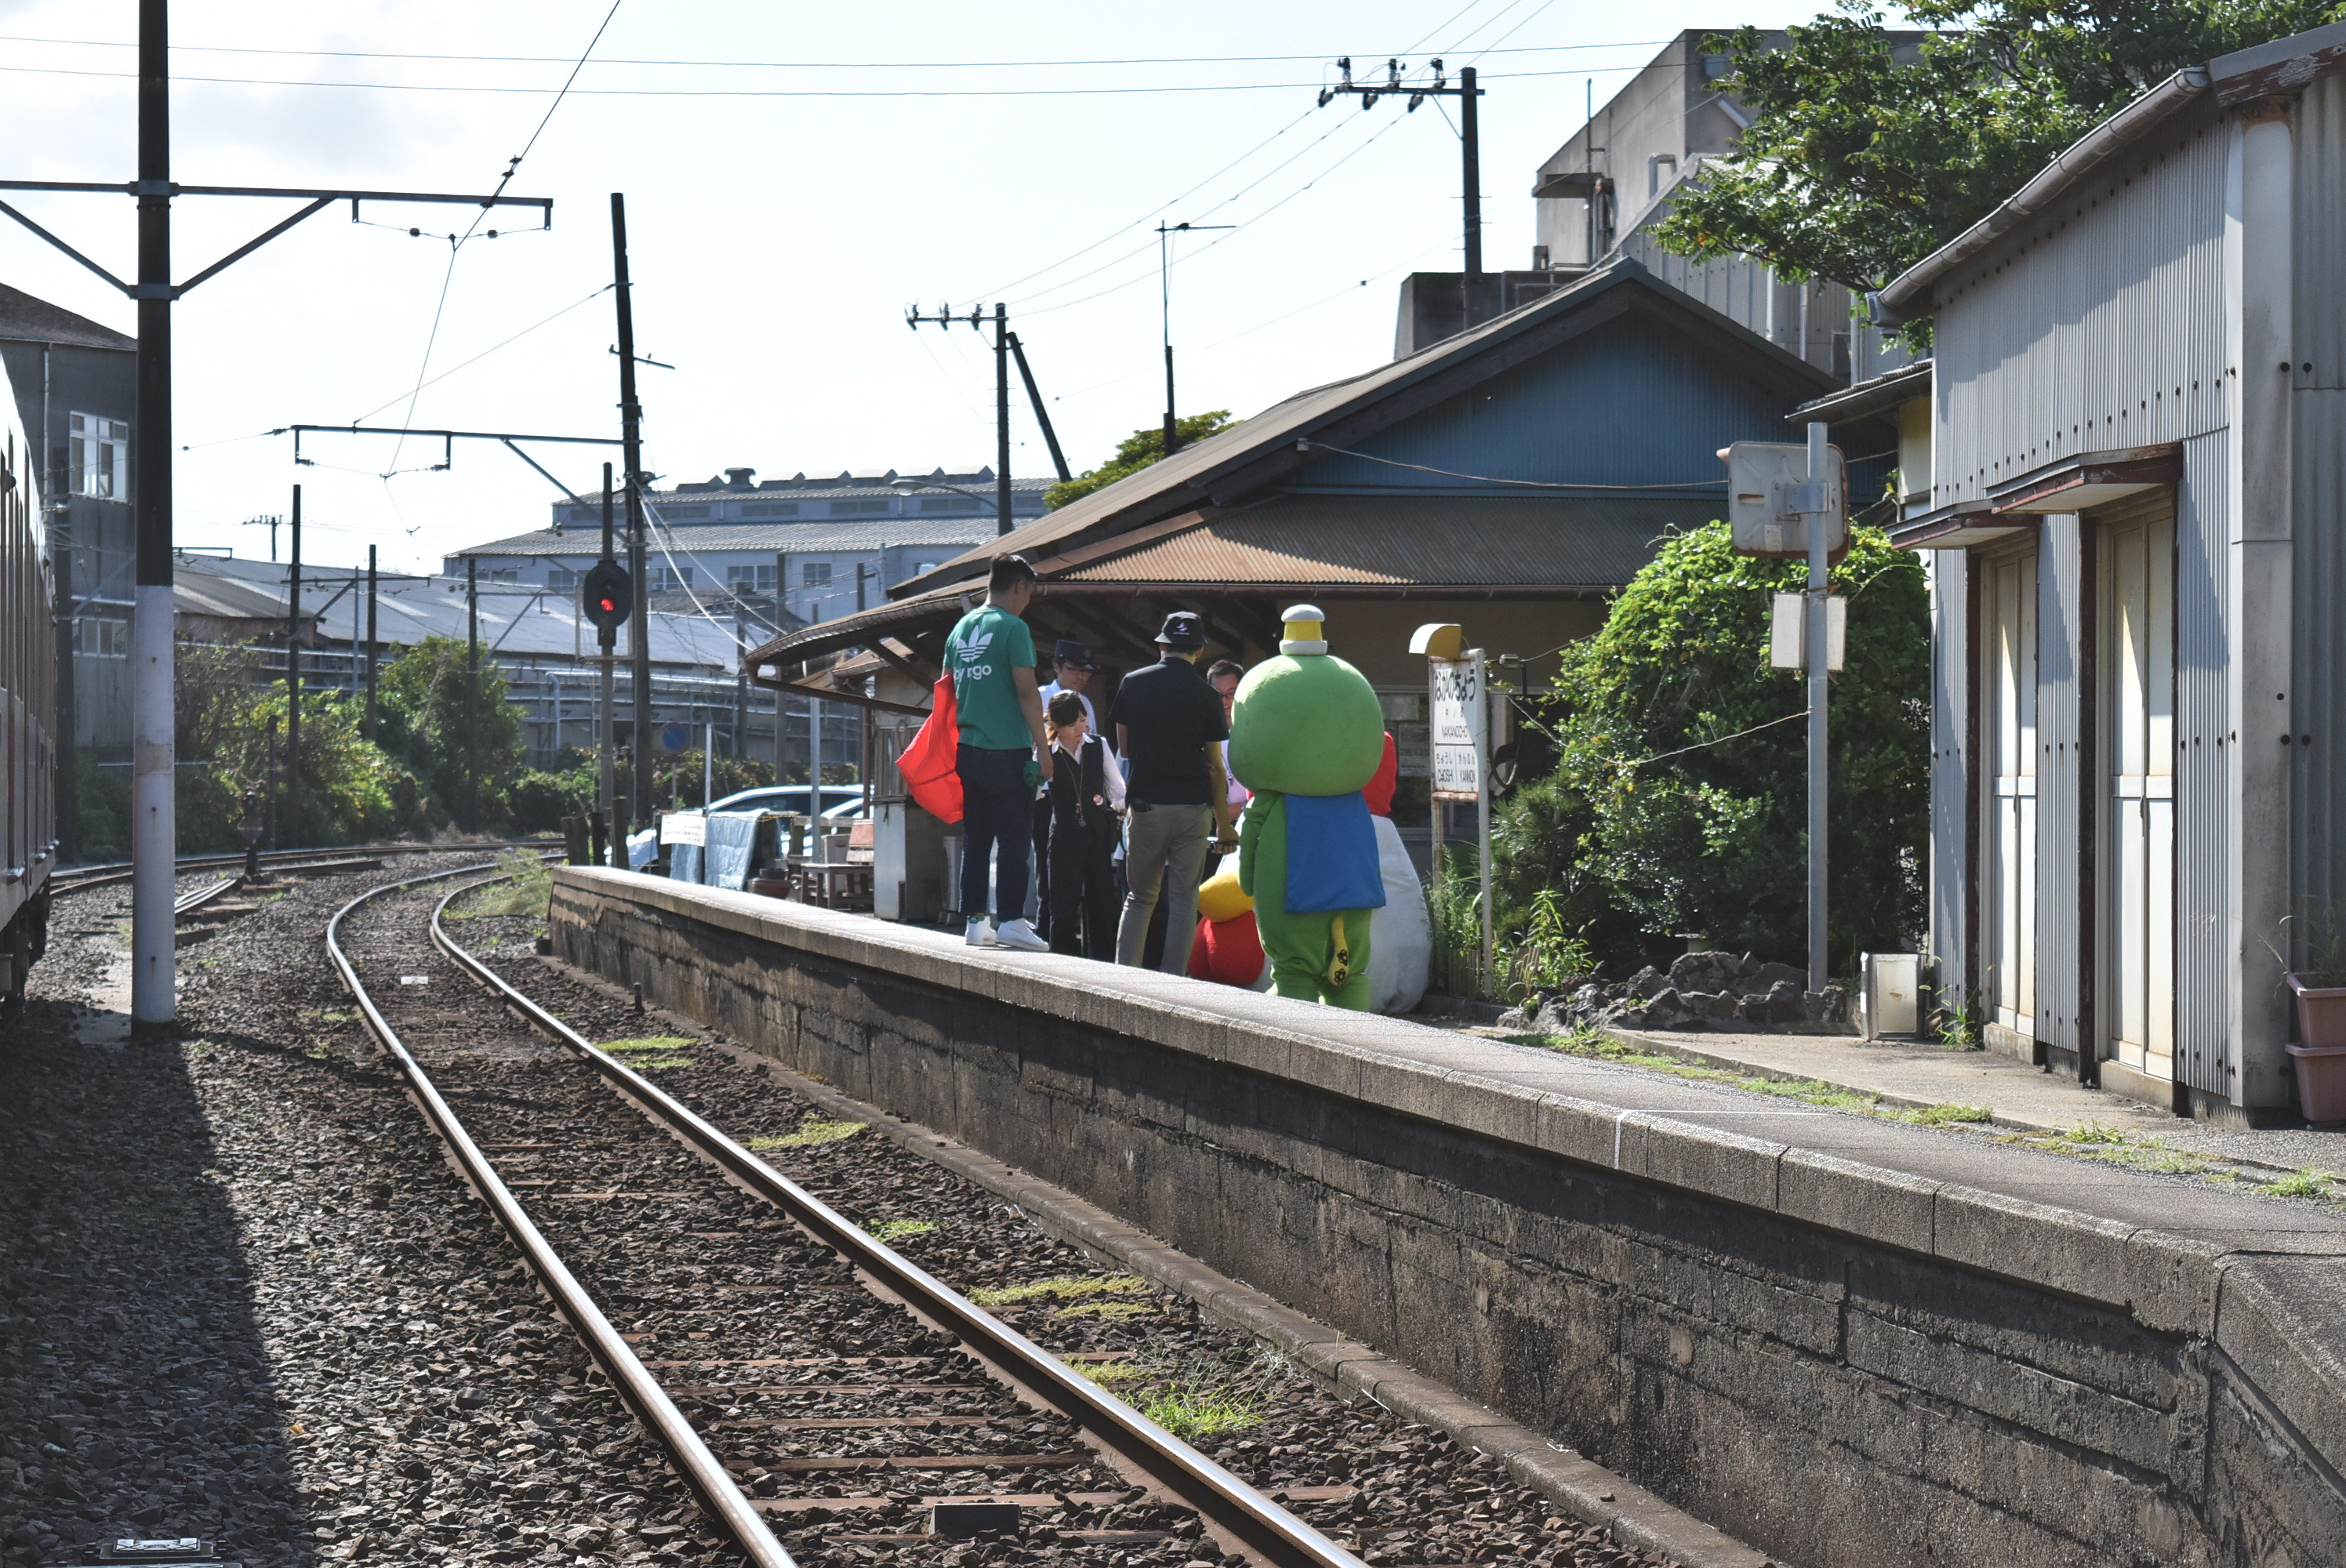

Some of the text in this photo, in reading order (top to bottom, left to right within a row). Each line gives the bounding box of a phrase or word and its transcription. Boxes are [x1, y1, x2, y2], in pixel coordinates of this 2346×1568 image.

[1434, 669, 1476, 702] なかのちょう
[1441, 725, 1468, 738] NAKANOCHO
[1436, 752, 1453, 764] ちょうし
[1458, 769, 1476, 783] KANNON
